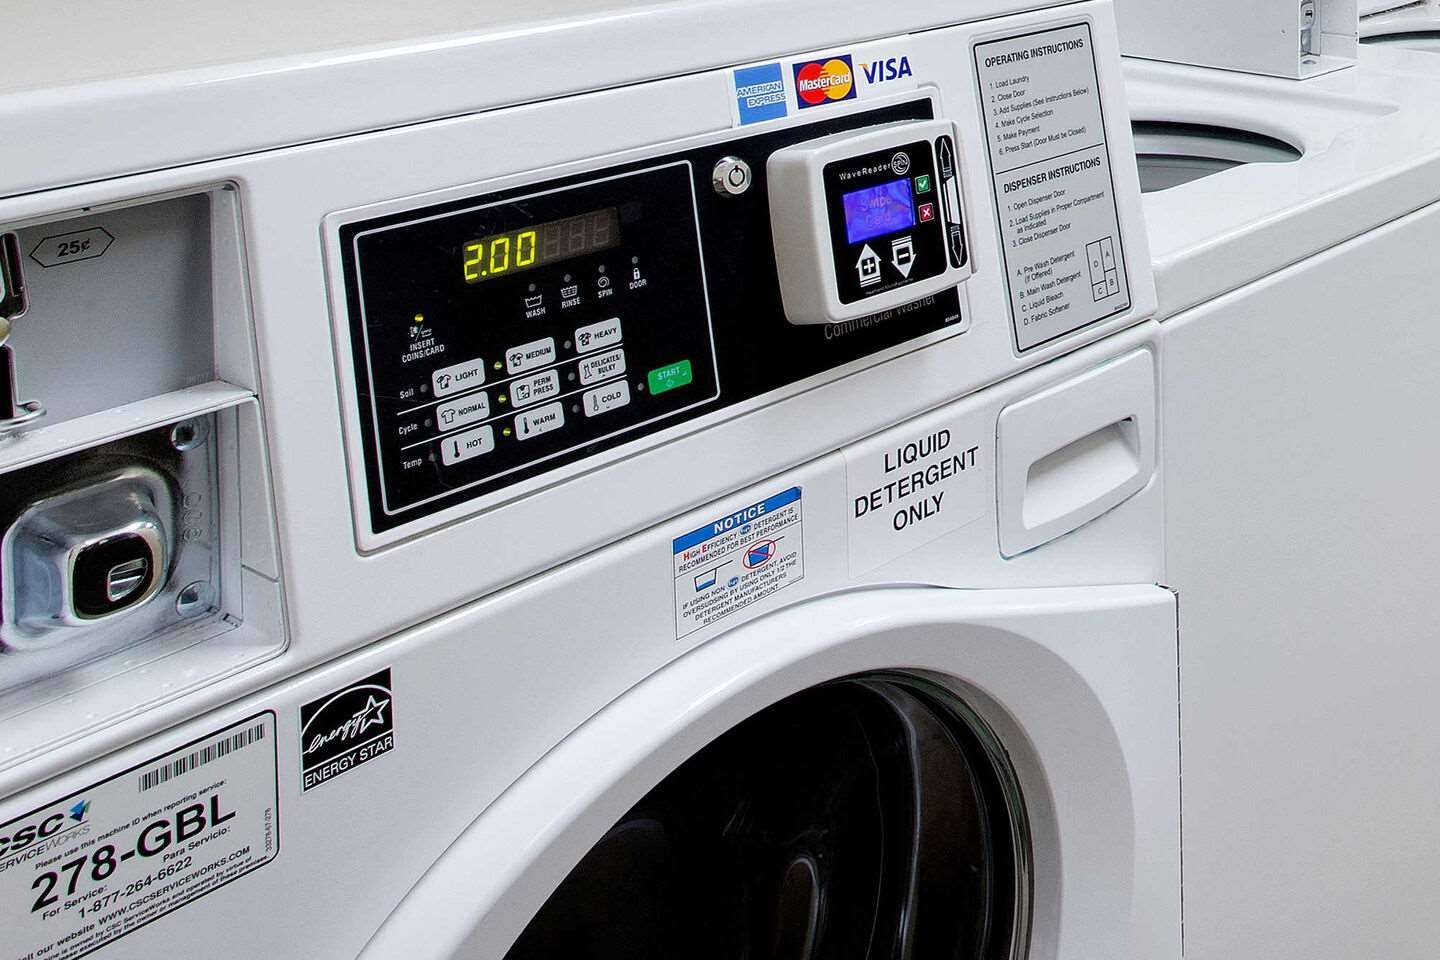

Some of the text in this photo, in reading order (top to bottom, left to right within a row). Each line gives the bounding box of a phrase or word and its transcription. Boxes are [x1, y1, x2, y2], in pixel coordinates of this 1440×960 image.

[985, 38, 1083, 68] OPERATING INSTRUCTIONS
[859, 55, 912, 84] VISA
[737, 82, 781, 98] AMERICAN
[799, 72, 851, 92] MasterCard
[995, 75, 1030, 89] Load Laundry
[748, 93, 786, 107] EXPRESS
[997, 89, 1025, 102] Close Door
[999, 106, 1010, 114] Add
[1011, 101, 1033, 112] Supplies
[1045, 91, 1072, 103] Instructions
[1001, 109, 1054, 127] Make Cycle Selection
[1003, 126, 1040, 140] Make Payment
[839, 163, 891, 181] WaveReader
[1004, 157, 1101, 193] DISPENSER INSTRUCTIONS
[1013, 189, 1066, 211] Open Dispenser Door
[1015, 215, 1029, 225] Load
[1029, 208, 1050, 220] Supplies
[1056, 202, 1072, 212] Proper
[1073, 191, 1104, 207] Compartment
[1018, 222, 1071, 245] Close Dispenser Door
[57, 238, 90, 257] 25¢
[464, 231, 536, 280] 2.00
[1034, 260, 1049, 270] Wash
[1050, 251, 1075, 265] Detergent
[1094, 260, 1098, 268] D
[629, 279, 647, 289] DOOR
[1027, 271, 1081, 296] Main Wash Detergent
[562, 297, 581, 309] RINSE
[598, 289, 613, 298] SPIN
[1029, 291, 1064, 310] Liquid Bleach
[526, 307, 546, 318] WASH
[1031, 303, 1070, 323] Fabric Softener
[594, 328, 617, 339] HEAVY
[402, 344, 445, 363] COINS/CARD
[410, 338, 435, 351] INSERT
[526, 347, 552, 360] MEDIUM
[591, 354, 621, 369] DELICATES/
[598, 364, 616, 374] BULKY
[455, 369, 479, 381] LIGHT
[533, 376, 551, 387] PERM
[658, 367, 680, 380] START
[400, 388, 414, 399] Soil
[534, 384, 553, 396] PRESS
[602, 392, 621, 403] COLD
[458, 402, 486, 416] NORMAL
[399, 423, 418, 435] Cycle
[533, 413, 556, 426] WARM
[467, 438, 483, 449] HOT
[884, 429, 950, 473] LIQUID
[403, 458, 423, 470] Temp
[854, 446, 979, 518] DETERGENT
[713, 503, 765, 534] NOTICE
[893, 492, 944, 532] ONLY
[679, 513, 798, 573] RECOMMENDED FOR BEST PERFORMANCE
[683, 507, 794, 561] HIGH EFFICIENCY DETERGENT IS
[682, 551, 797, 610] IF USING NON DETERGENT, AVOID
[683, 591, 729, 618] OVERSUDSING
[730, 587, 739, 596] BY
[740, 578, 759, 591] USING
[760, 570, 775, 581] ONLY
[785, 559, 797, 568] THE
[695, 571, 787, 621] DETERGENT MANUFACTURERS
[703, 599, 751, 624] RECOMMENDED
[305, 736, 392, 788] ENERGY STAR
[35, 779, 227, 870] Please use this machine ID when reporting service:
[0, 825, 91, 872] ERVICEWORKS
[31, 794, 236, 913] 278-GBL
[163, 826, 231, 863] Para Servicio:
[79, 856, 193, 918] 1-877-264-6622
[37, 845, 251, 957] our website WWW.CSCSERVICEWORKS.COM
[42, 884, 108, 920] For Service:
